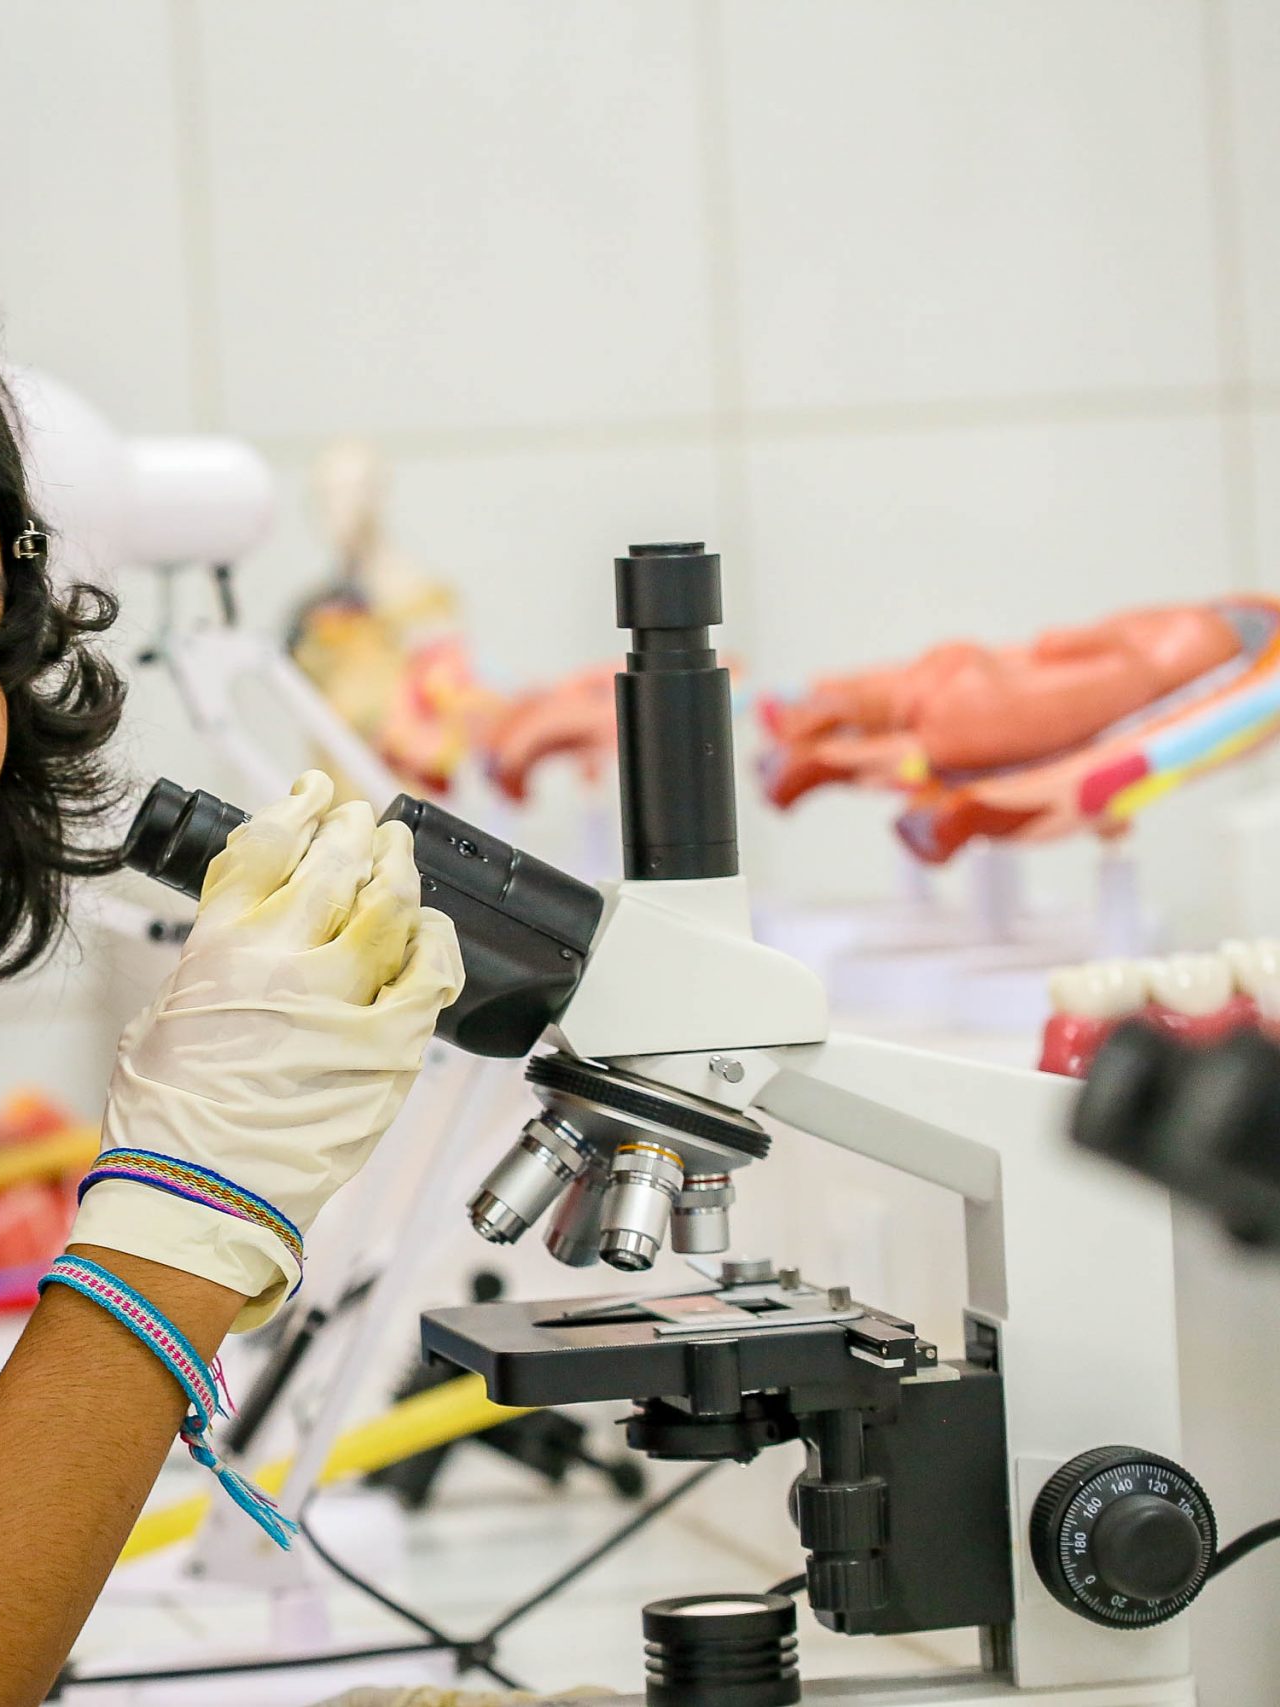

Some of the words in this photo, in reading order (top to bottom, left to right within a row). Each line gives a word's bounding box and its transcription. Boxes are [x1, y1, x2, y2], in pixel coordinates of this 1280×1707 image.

[1111, 1478, 1133, 1495] 140
[1148, 1478, 1169, 1495] 120
[1083, 1497, 1102, 1519] 160
[1178, 1497, 1195, 1519] 100
[1074, 1531, 1087, 1555] 180
